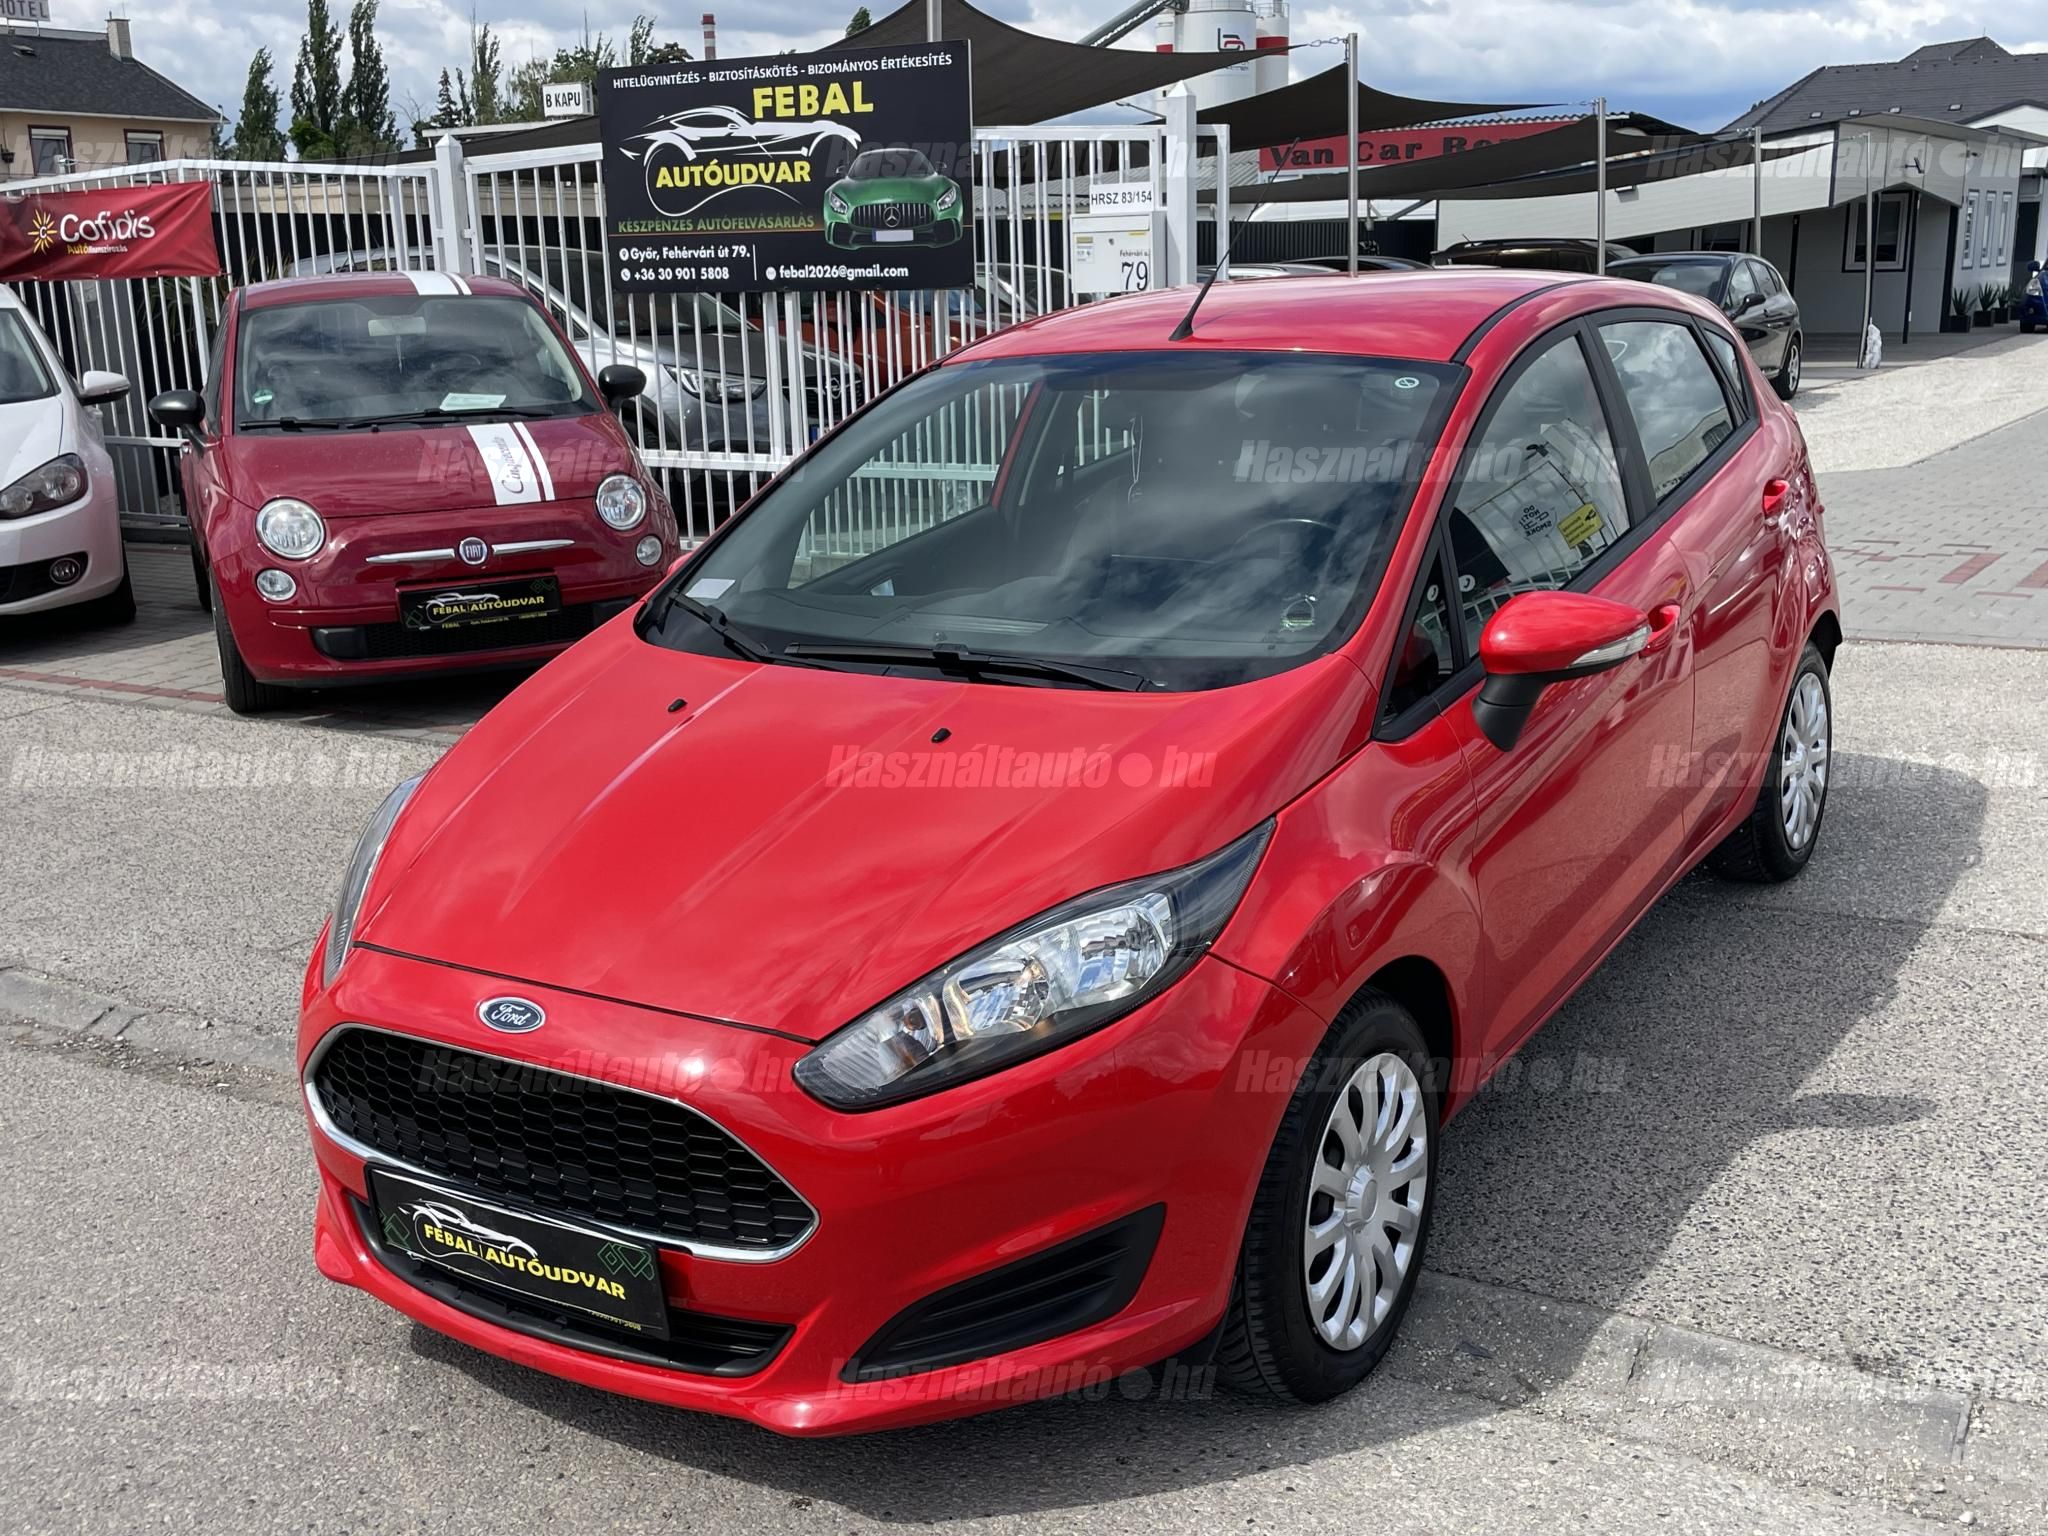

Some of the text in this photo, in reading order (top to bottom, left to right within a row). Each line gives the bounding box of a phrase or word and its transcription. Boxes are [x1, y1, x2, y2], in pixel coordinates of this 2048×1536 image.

[613, 71, 700, 89] HITELÜGYINTÉZÉS
[709, 63, 799, 82] BIZTOSÍTÁSKÖTÉS
[808, 59, 879, 75] BIZOMÁNYOS
[881, 52, 953, 70] ÉRTÉKESÍTÉS
[545, 92, 580, 108] B KAPU
[752, 80, 874, 119] FEBAL
[1270, 147, 1334, 166] Van
[655, 158, 812, 188] AUTÓUDVAR
[1091, 190, 1152, 205] HRSZ 83/154
[60, 210, 156, 243] Cofidis
[618, 212, 815, 233] KÉSZPÉNZES AUTÓFELVÁSÁRLÁS
[630, 245, 751, 263] Győr, Fehérvári út 79.
[634, 266, 730, 281] +36 30 901 5808
[779, 263, 909, 281] febal2026@gmail.com
[1121, 261, 1148, 291] 79
[465, 544, 483, 558] FIAT
[433, 604, 467, 616] FEBAL
[491, 1003, 532, 1026] Ford
[423, 1223, 627, 1300] FEBAL AUTÓUDVAR
